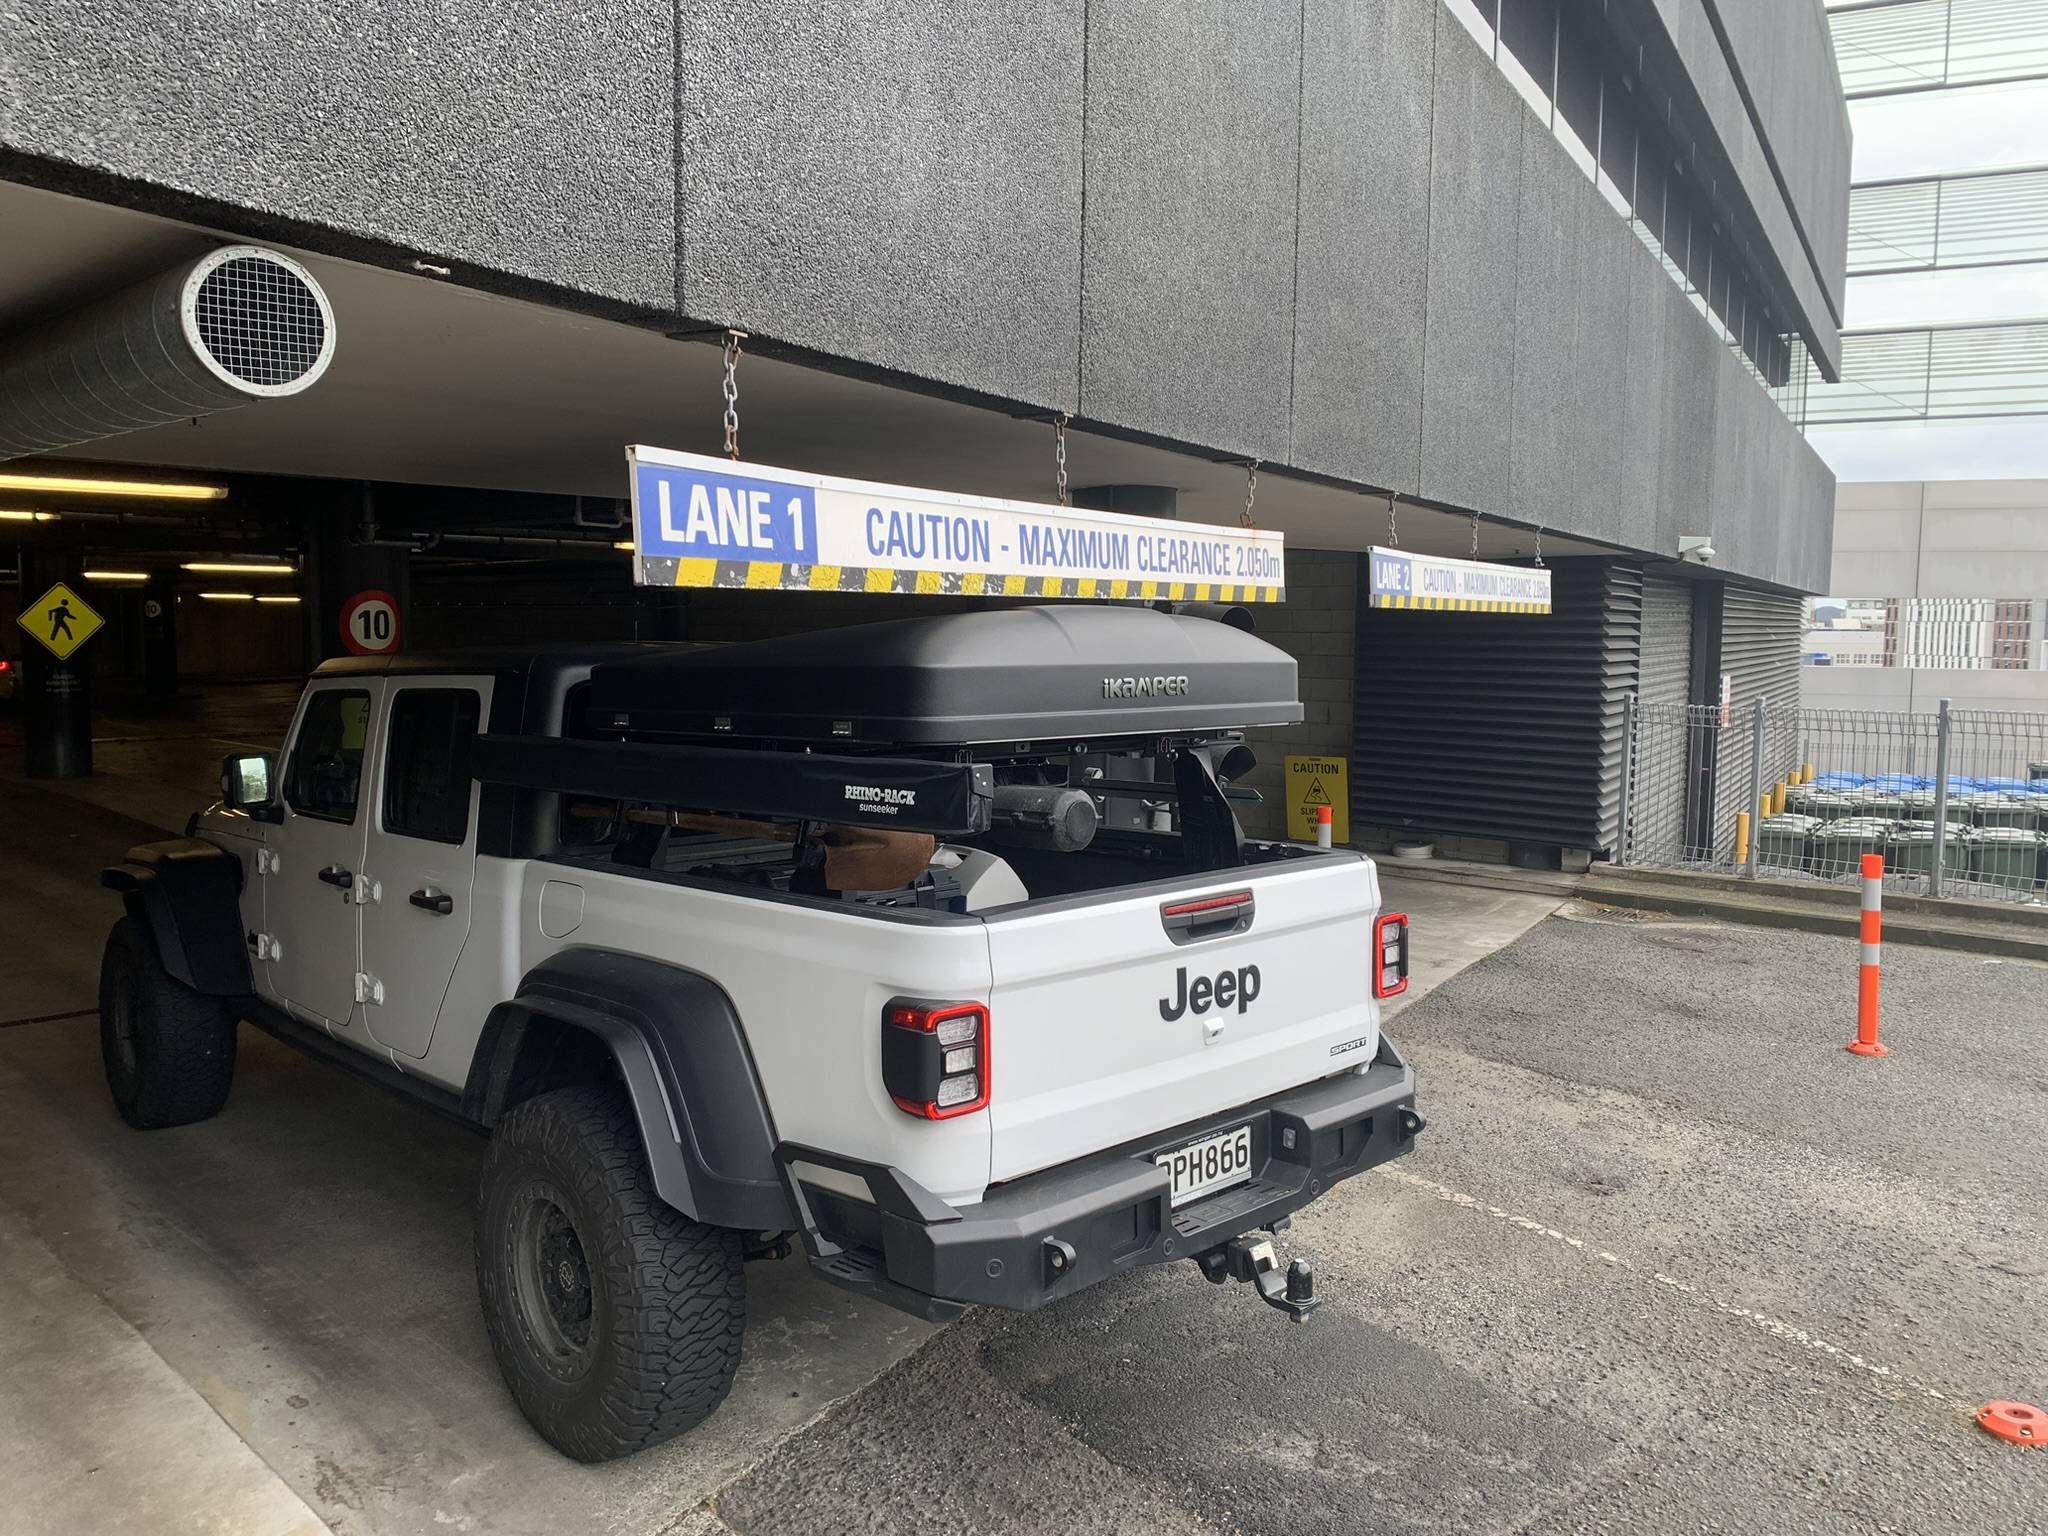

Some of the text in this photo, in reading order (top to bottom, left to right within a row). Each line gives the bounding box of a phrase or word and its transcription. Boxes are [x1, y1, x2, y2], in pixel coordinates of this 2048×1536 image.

[658, 479, 806, 552] LANE 1
[866, 507, 991, 563] CAUTION
[1019, 524, 1130, 571] MAXIMUM
[1136, 535, 1231, 577] CLEARANCE
[1236, 542, 1281, 580] 2.050m
[1376, 560, 1411, 591] LANE 2
[1423, 568, 1457, 593] CAUTION
[1464, 573, 1497, 596] MAXIMUM
[1499, 576, 1531, 598] CLEARANCE
[145, 604, 157, 615] 10
[358, 609, 390, 640] 10
[1293, 763, 1339, 774] CAUTION
[844, 785, 916, 806] RHINO-RACK
[859, 801, 899, 815] sunseeker
[1159, 963, 1261, 1023] Jeep
[1330, 1038, 1367, 1055] SPORT
